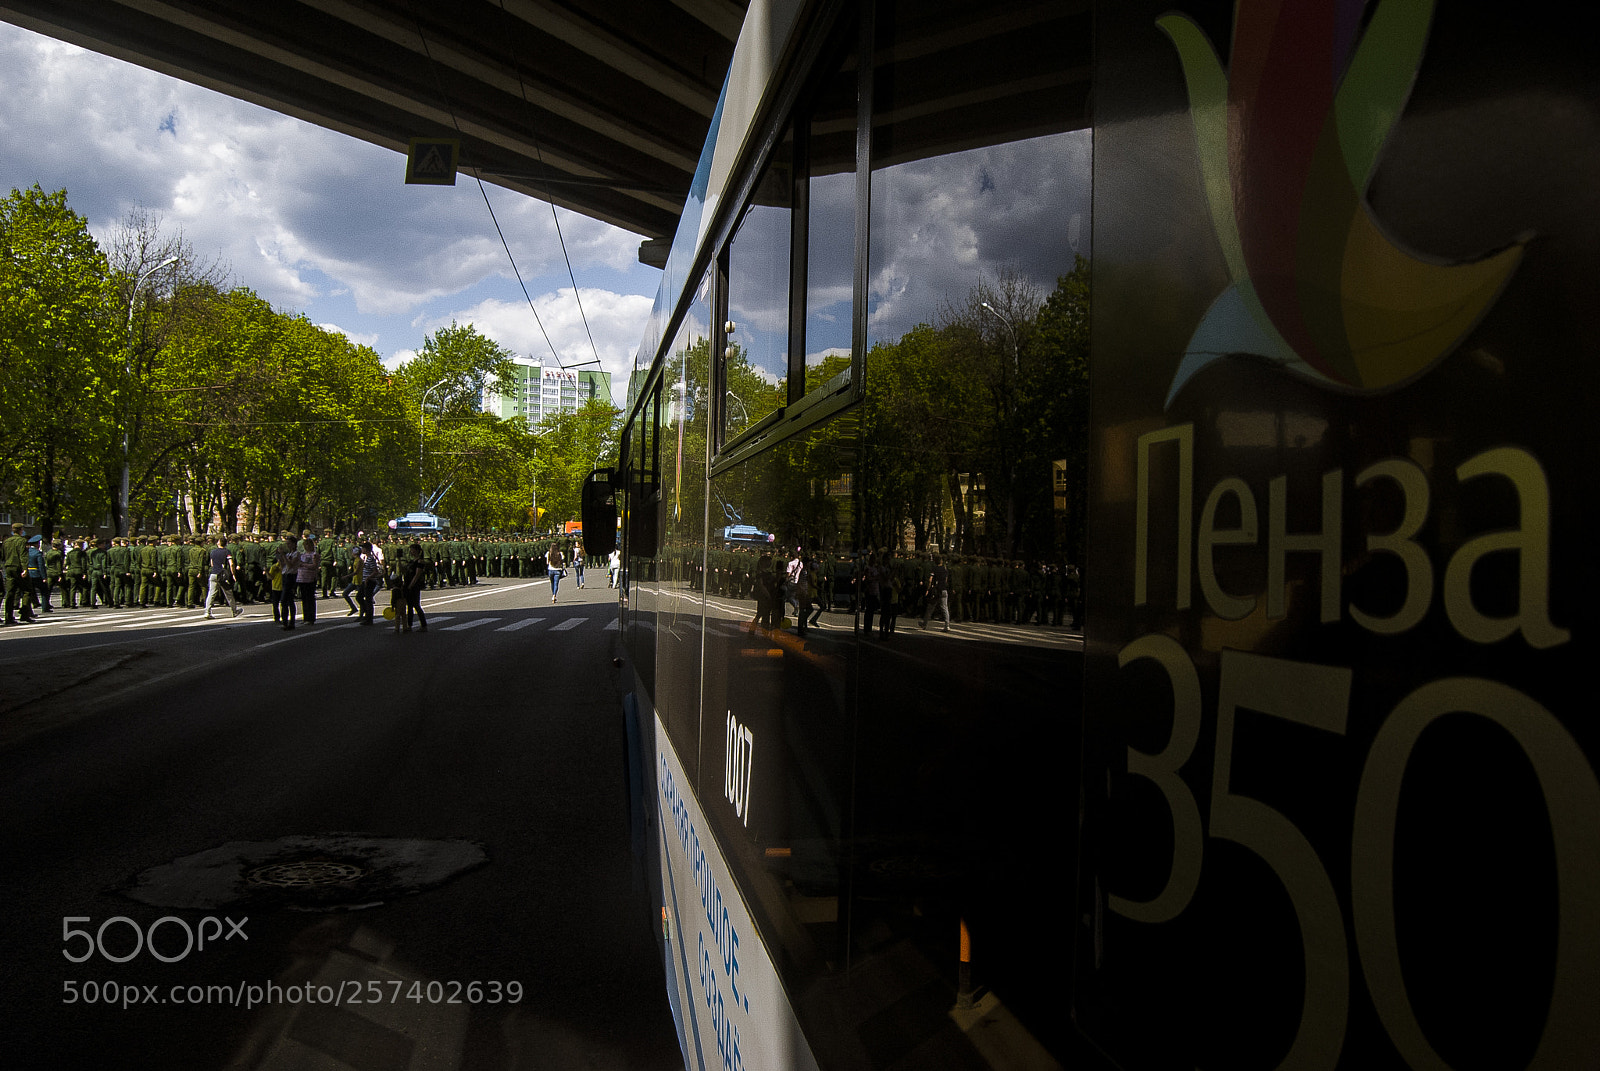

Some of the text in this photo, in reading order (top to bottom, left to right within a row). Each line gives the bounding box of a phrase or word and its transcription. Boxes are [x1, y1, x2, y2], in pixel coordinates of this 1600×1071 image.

[1133, 422, 1572, 650] Пенза
[725, 710, 753, 828] 1007
[1107, 634, 1600, 1071] 350
[690, 821, 740, 1008] ПРОШЛОЕ
[698, 931, 746, 1071] СОЗДАЁ
